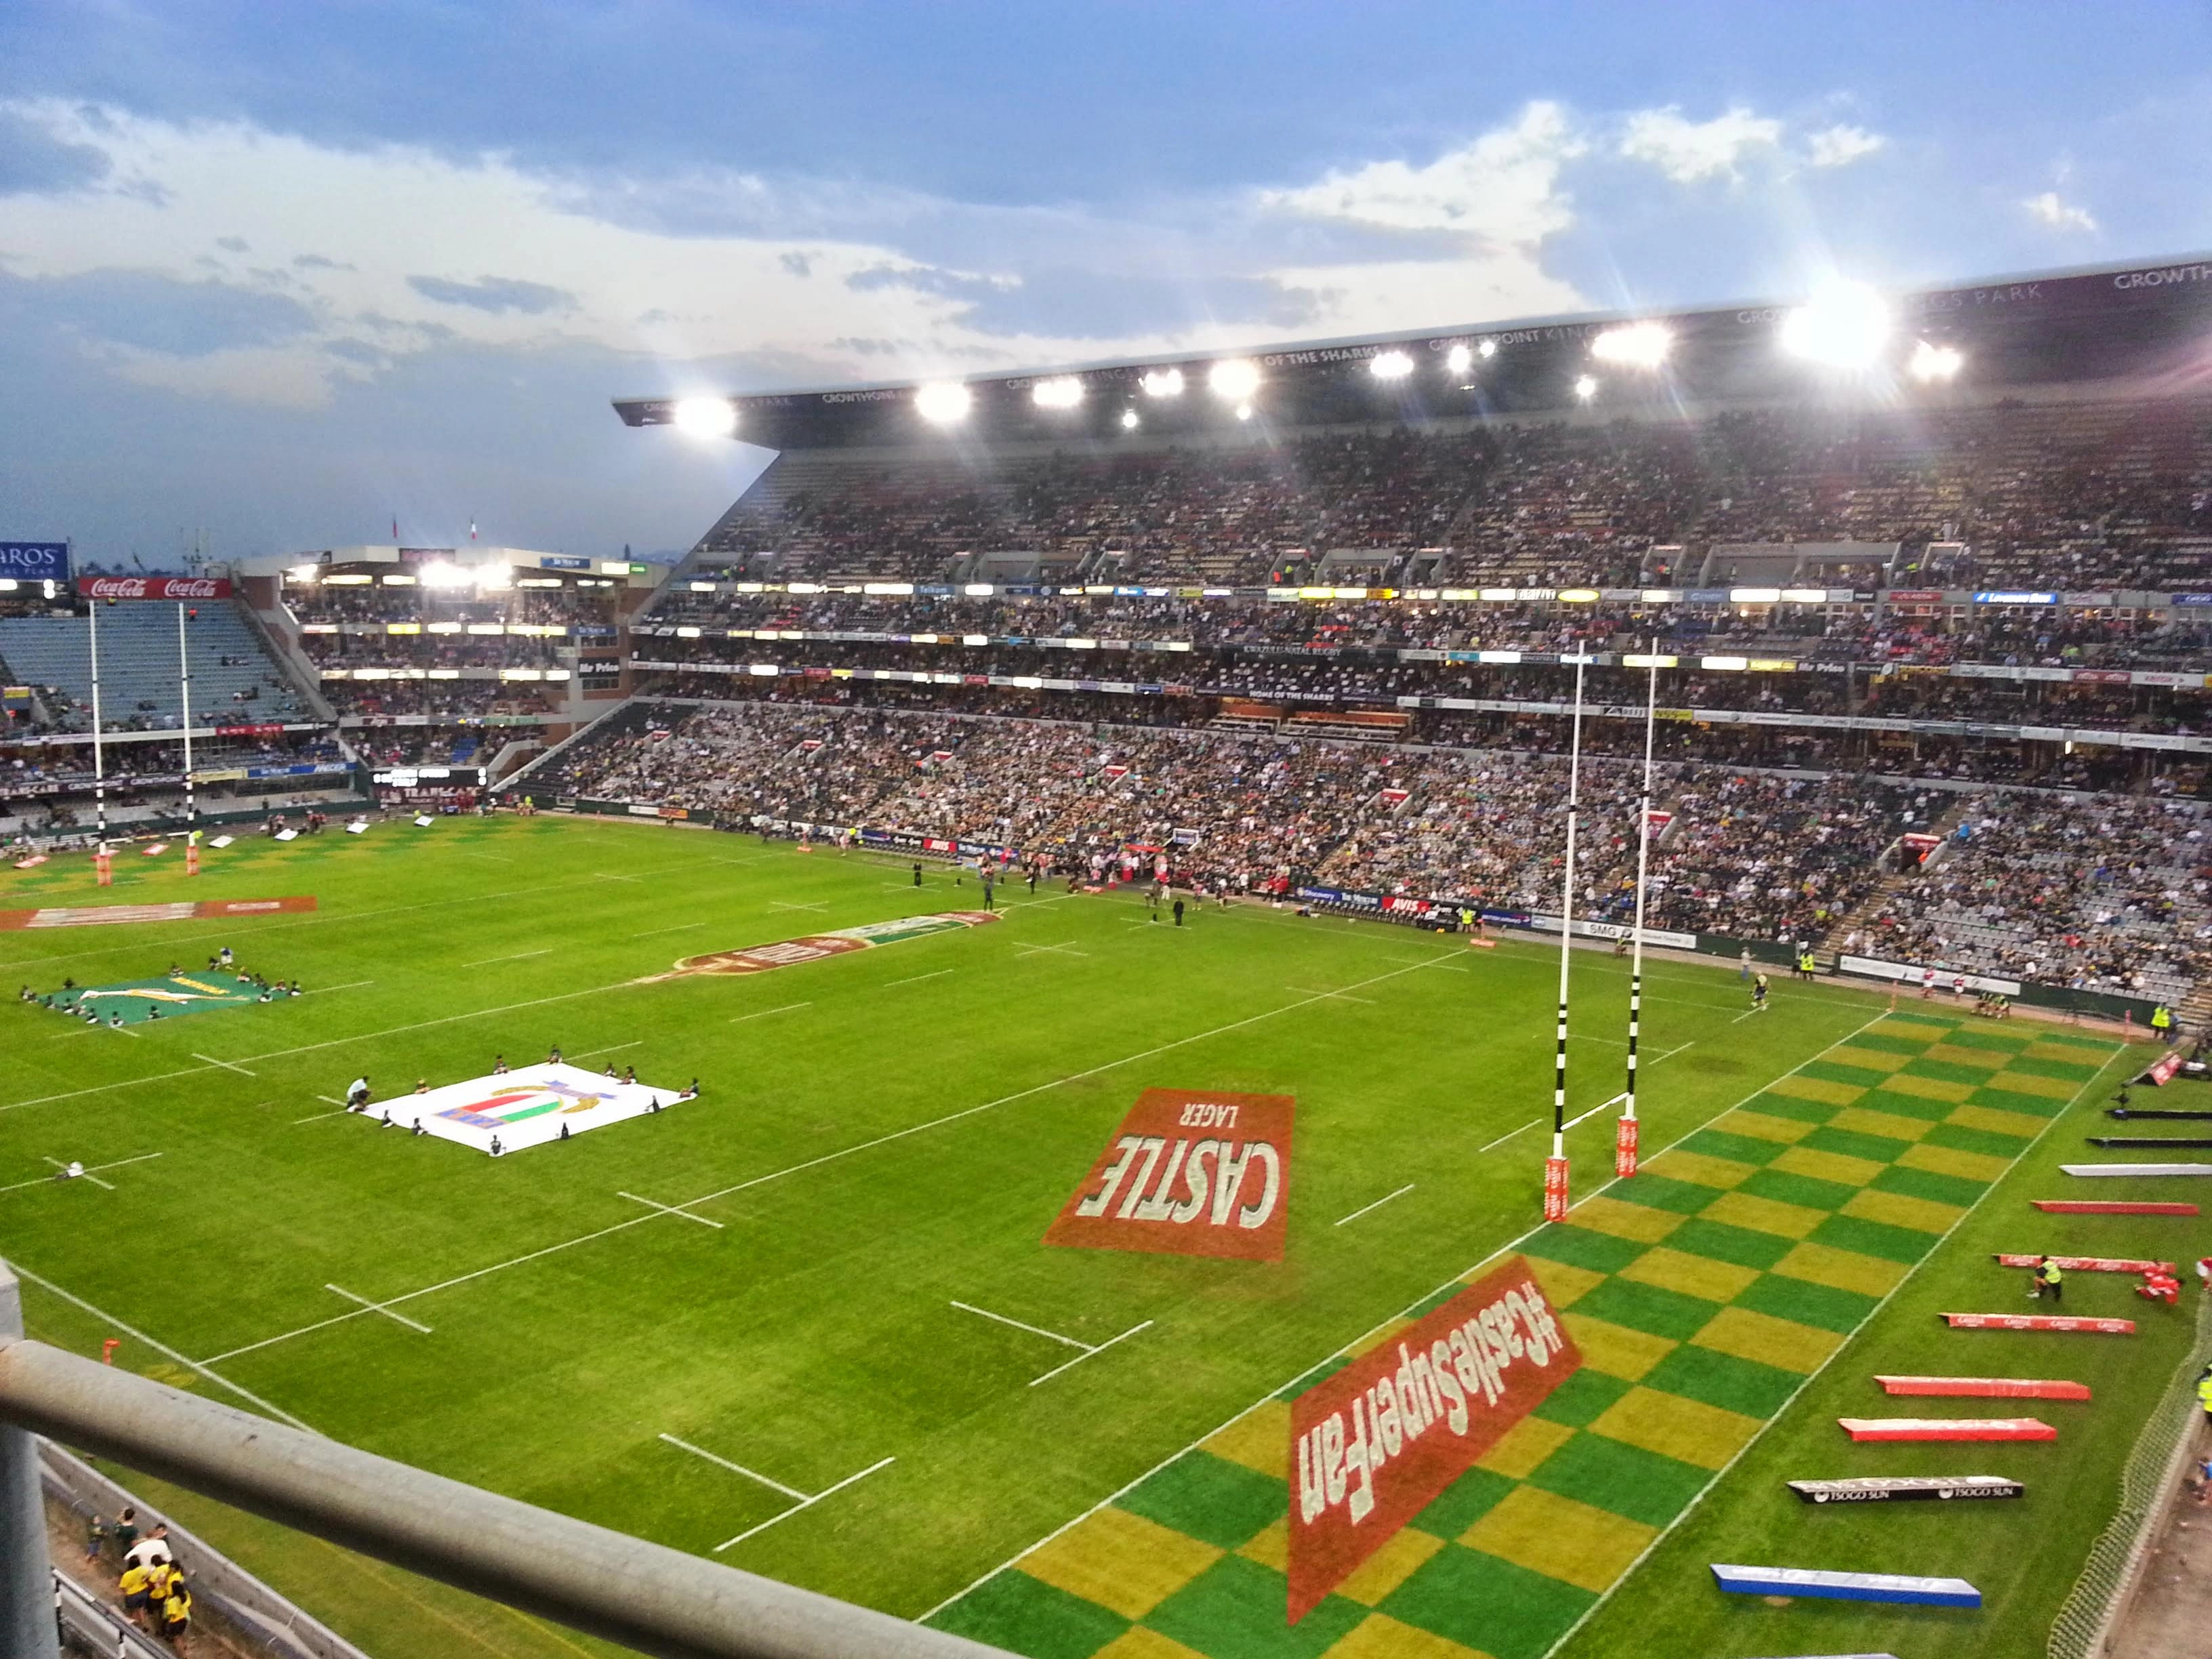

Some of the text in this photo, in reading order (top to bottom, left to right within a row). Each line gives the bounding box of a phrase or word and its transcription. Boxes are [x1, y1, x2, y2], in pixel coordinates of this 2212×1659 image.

[1286, 351, 1318, 365] THE
[1319, 345, 1378, 362] SHARKS
[595, 662, 619, 673] Price
[1249, 690, 1274, 699] HOME
[1274, 691, 1286, 699] OF
[1286, 691, 1302, 700] THE
[1303, 693, 1335, 701] SHARKS
[1393, 899, 1418, 912] AVIS
[1589, 924, 1616, 937] SMG
[1179, 1103, 1239, 1128] LAGER
[1076, 1135, 1280, 1229] CASTLE
[1298, 1280, 1563, 1526] #CastleSuperFan
